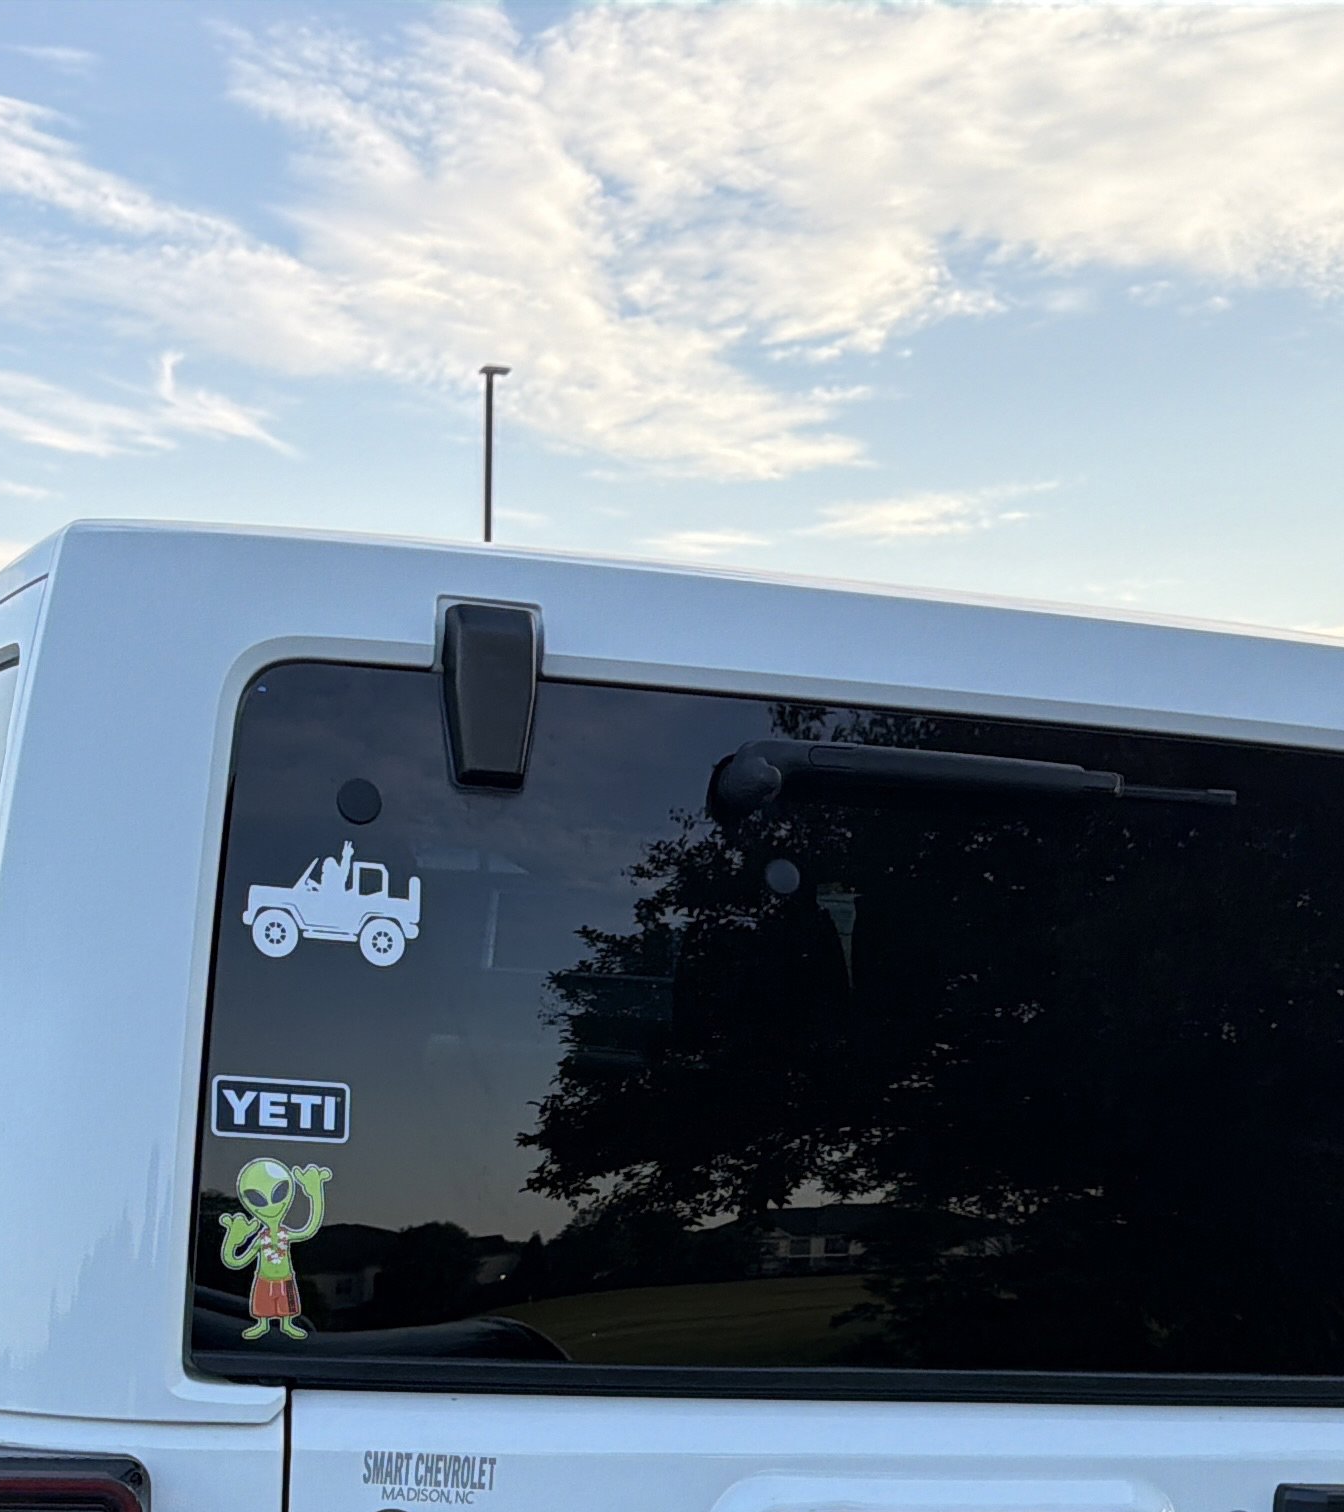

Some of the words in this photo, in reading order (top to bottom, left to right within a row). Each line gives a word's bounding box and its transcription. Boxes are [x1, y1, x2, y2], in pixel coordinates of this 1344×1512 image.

[222, 1089, 337, 1131] YETI
[362, 1450, 412, 1486] SMART
[414, 1453, 497, 1491] CHEVROLET
[381, 1486, 452, 1504] MADISON,
[454, 1490, 475, 1504] NC
